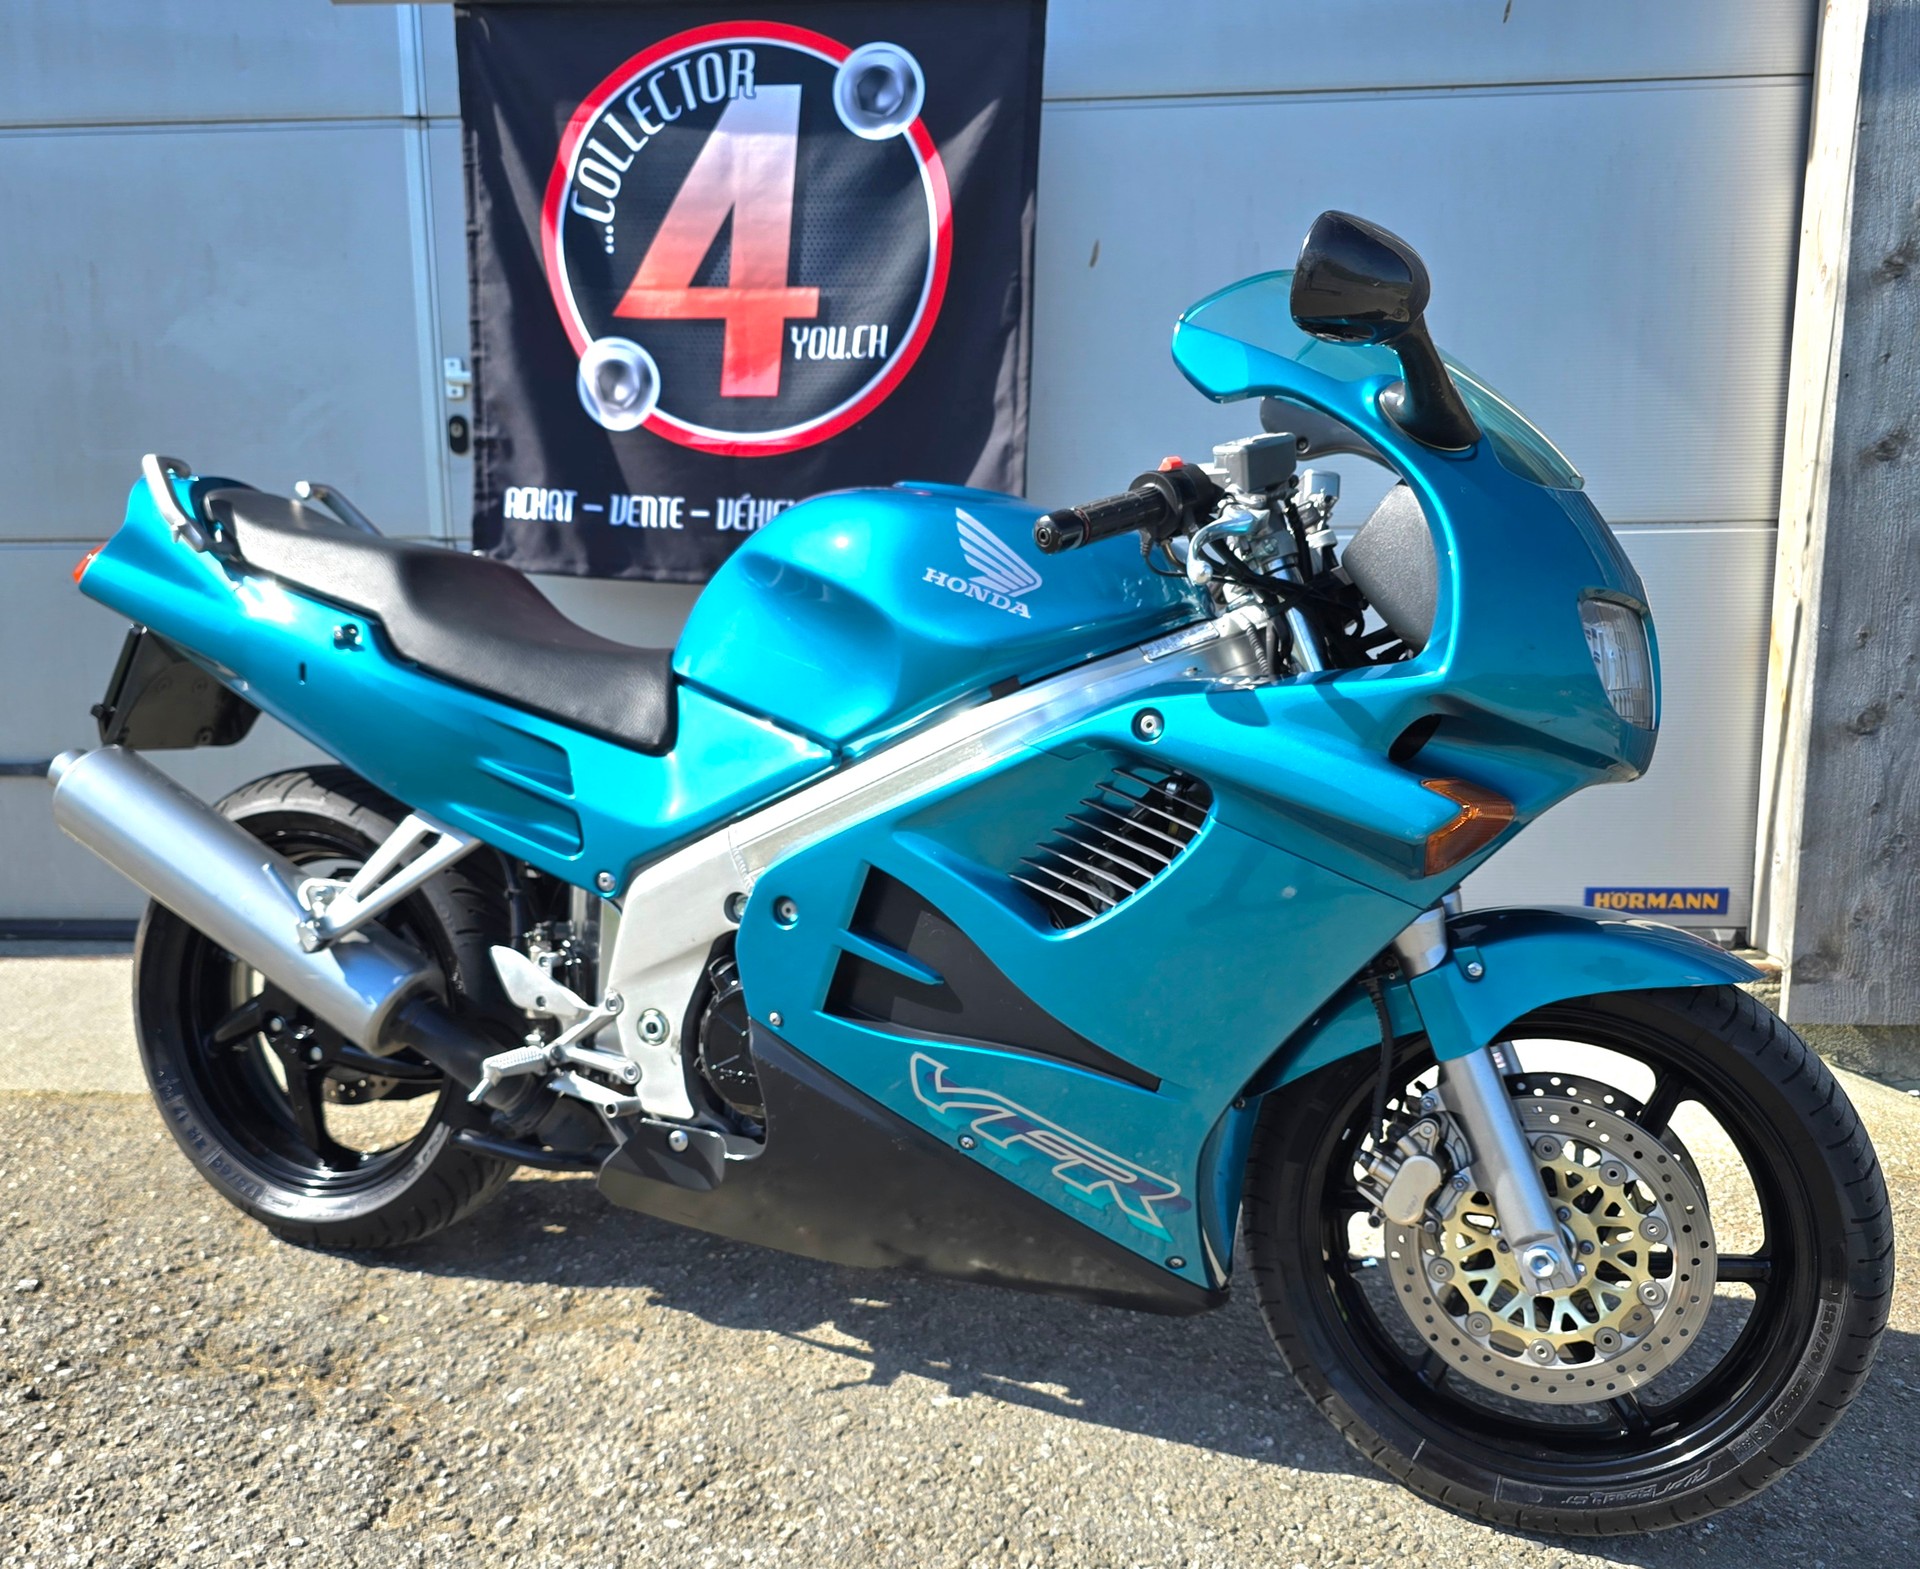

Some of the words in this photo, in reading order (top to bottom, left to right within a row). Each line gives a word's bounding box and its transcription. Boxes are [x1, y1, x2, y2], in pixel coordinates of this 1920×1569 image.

[611, 83, 820, 397] 4
[790, 324, 889, 360] YOU.CH
[503, 486, 578, 523] ACHAT
[609, 494, 685, 530] VENTE
[716, 493, 795, 531] VÉHI
[922, 567, 1031, 619] HONDA
[910, 1052, 1181, 1228] VFR
